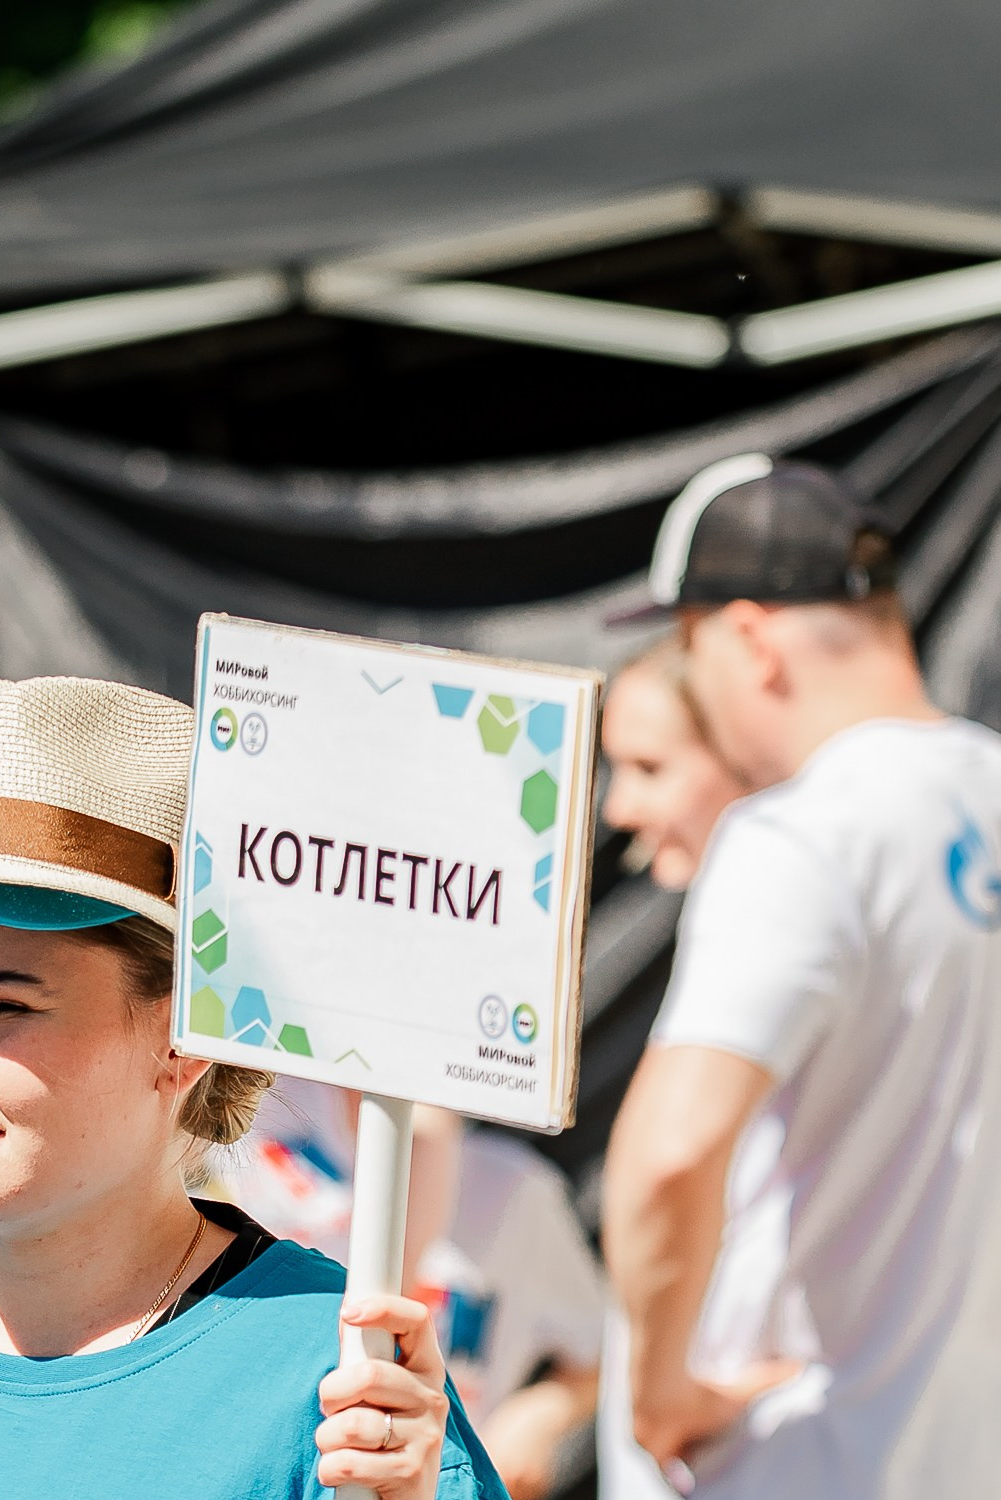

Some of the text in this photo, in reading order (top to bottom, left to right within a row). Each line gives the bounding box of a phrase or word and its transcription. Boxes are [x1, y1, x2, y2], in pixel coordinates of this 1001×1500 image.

[215, 659, 269, 680] МИРовой
[213, 683, 299, 710] ХОББИХОРСИНГ
[237, 823, 503, 926] КОТЛЕТКИ
[479, 1045, 536, 1068] МИРовой
[445, 1063, 537, 1093] ХОББИХОРСИНГ
